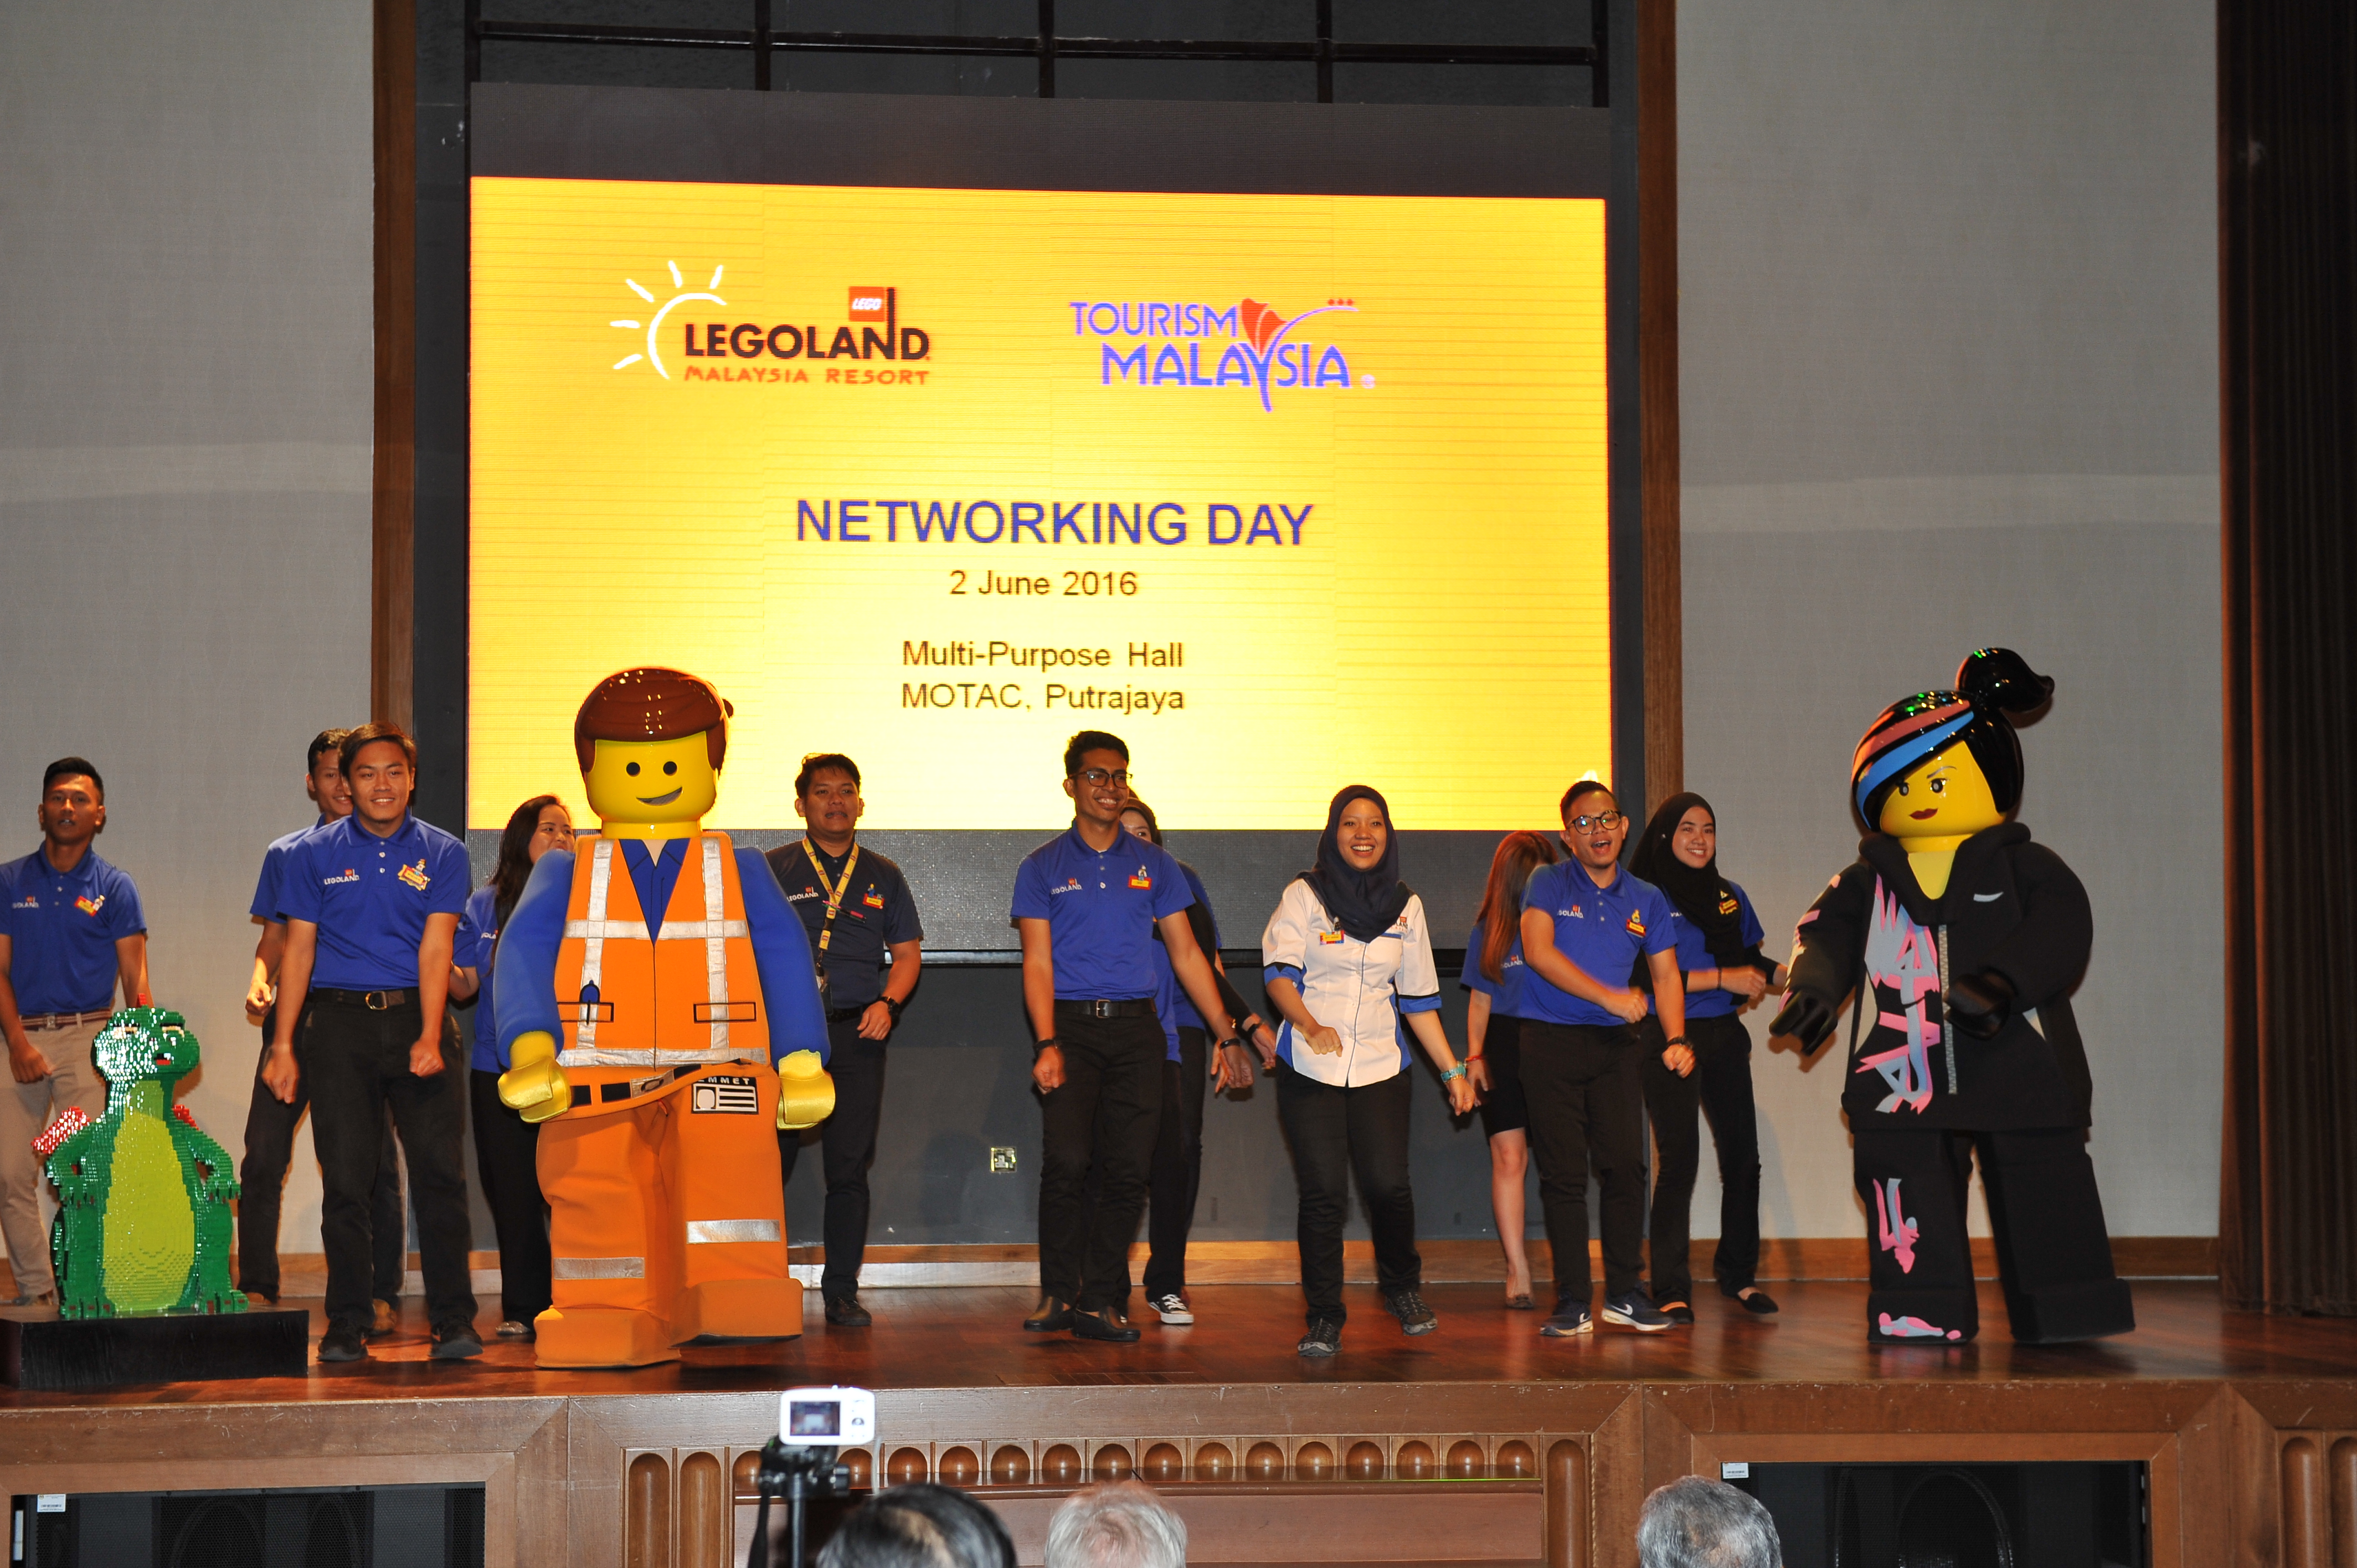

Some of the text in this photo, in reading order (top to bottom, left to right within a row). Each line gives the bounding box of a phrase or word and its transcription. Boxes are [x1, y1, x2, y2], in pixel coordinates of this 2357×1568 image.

[852, 297, 882, 311] LEGO
[686, 287, 930, 360] LEGOLAND
[1069, 302, 1238, 338] TOURISM
[684, 365, 930, 385] MALAYSIA RESORT
[1101, 340, 1352, 412] MALAYSIA
[797, 499, 1314, 545] NETWORKING DAY
[950, 570, 1138, 596] 2 June 2016
[903, 640, 1183, 673] Multi-Purpose Hall
[1046, 684, 1184, 715] Putrajaya
[324, 869, 360, 885] LEGOLAND
[1051, 878, 1082, 895] LEGOLAND
